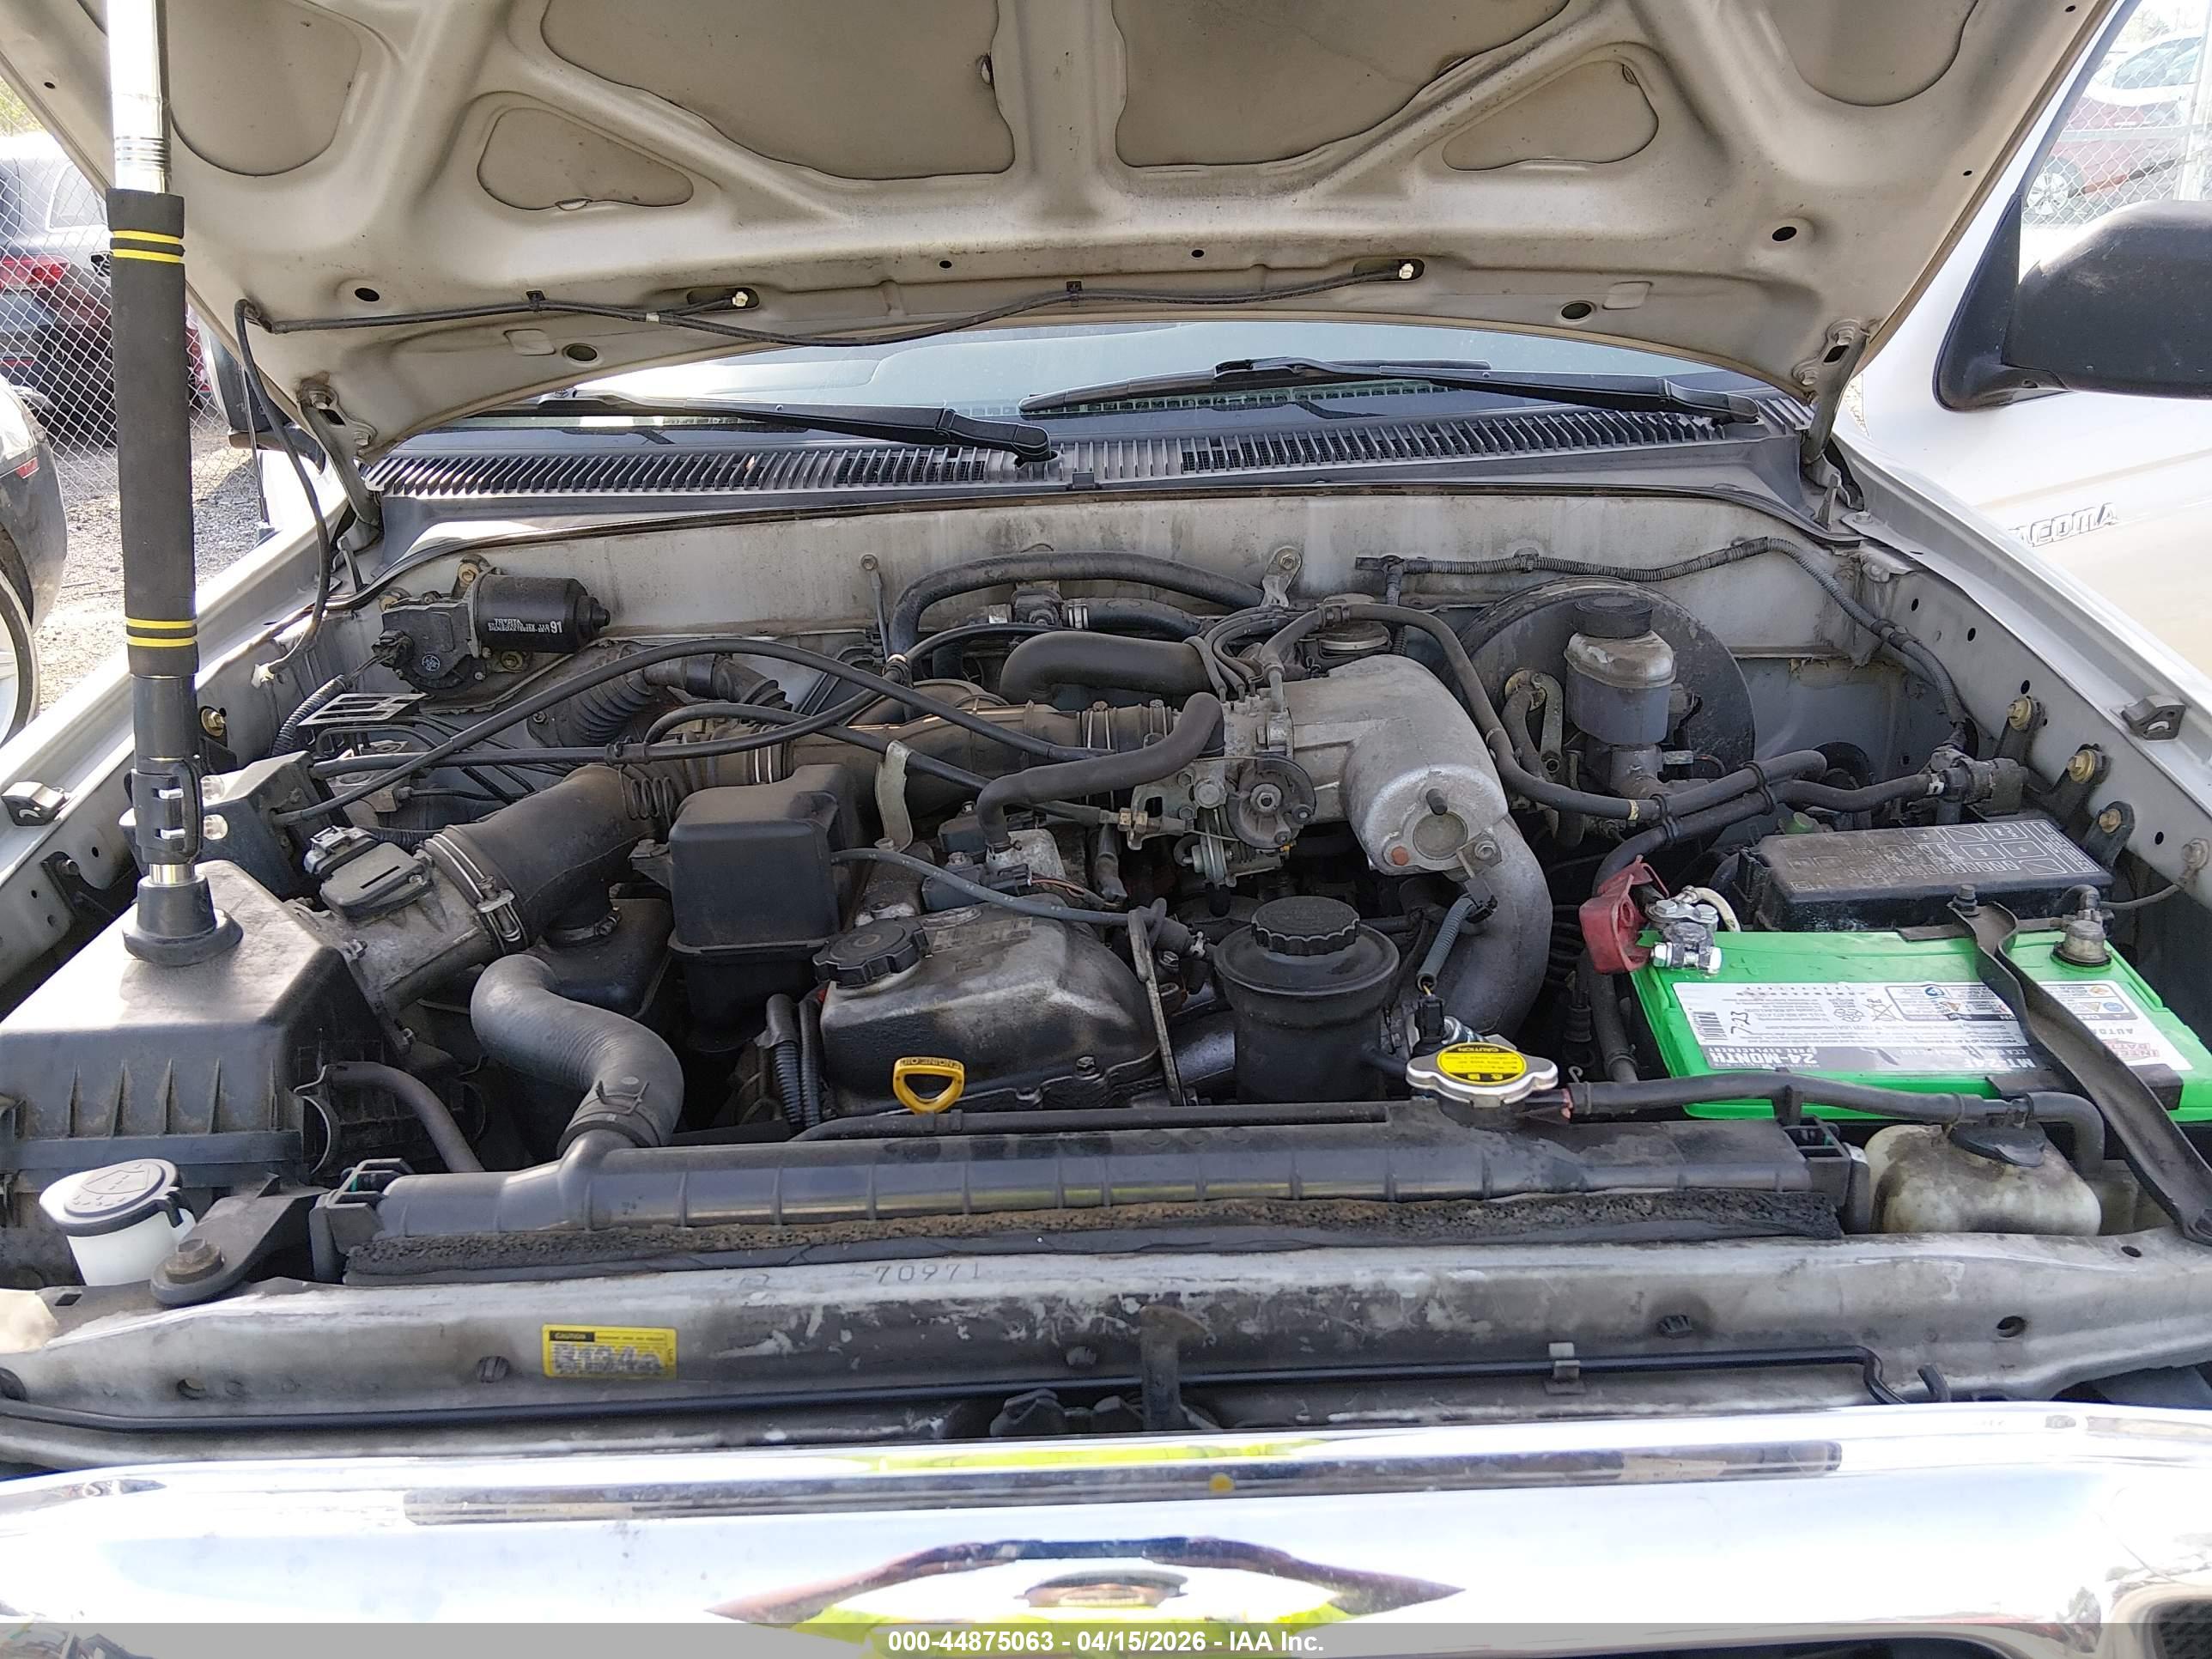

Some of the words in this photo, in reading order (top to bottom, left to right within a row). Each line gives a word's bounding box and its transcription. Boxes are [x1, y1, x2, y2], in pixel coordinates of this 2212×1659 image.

[2008, 502, 2116, 548] ACOMA
[550, 621, 562, 634] 91
[921, 1058, 961, 1070] ENGINE
[1709, 1053, 1819, 1065] 24-MONTH
[873, 1261, 979, 1285] 70971
